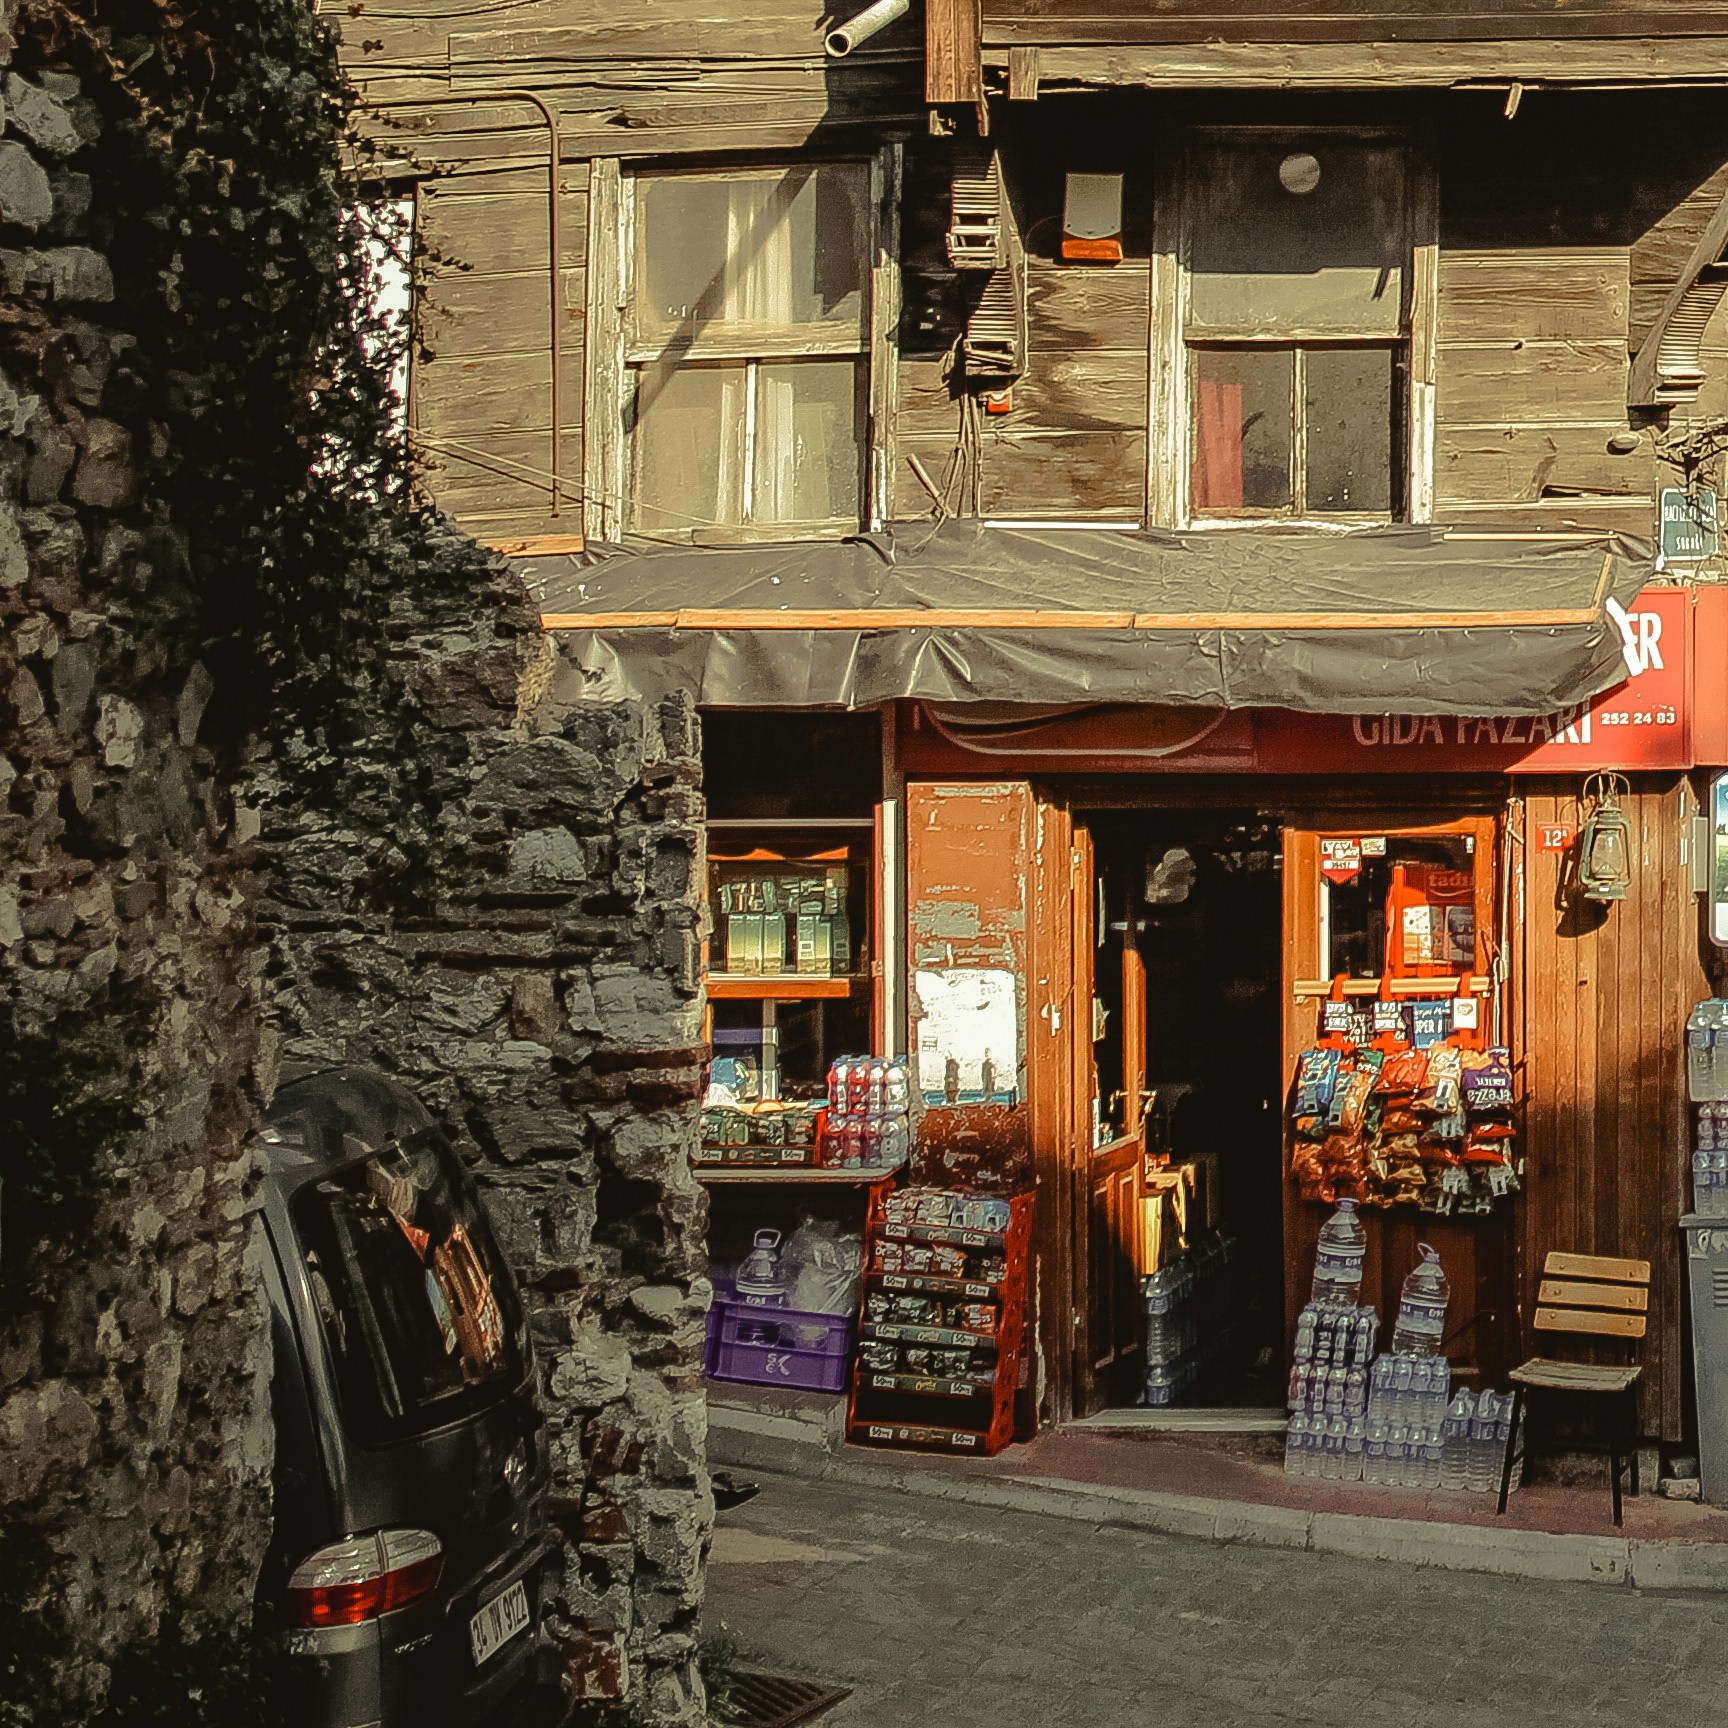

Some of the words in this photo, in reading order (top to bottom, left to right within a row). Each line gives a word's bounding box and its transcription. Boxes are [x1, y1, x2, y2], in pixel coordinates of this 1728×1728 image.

[1601, 712, 1629, 725] 252
[1633, 712, 1653, 725] 24
[1656, 712, 1676, 725] 83
